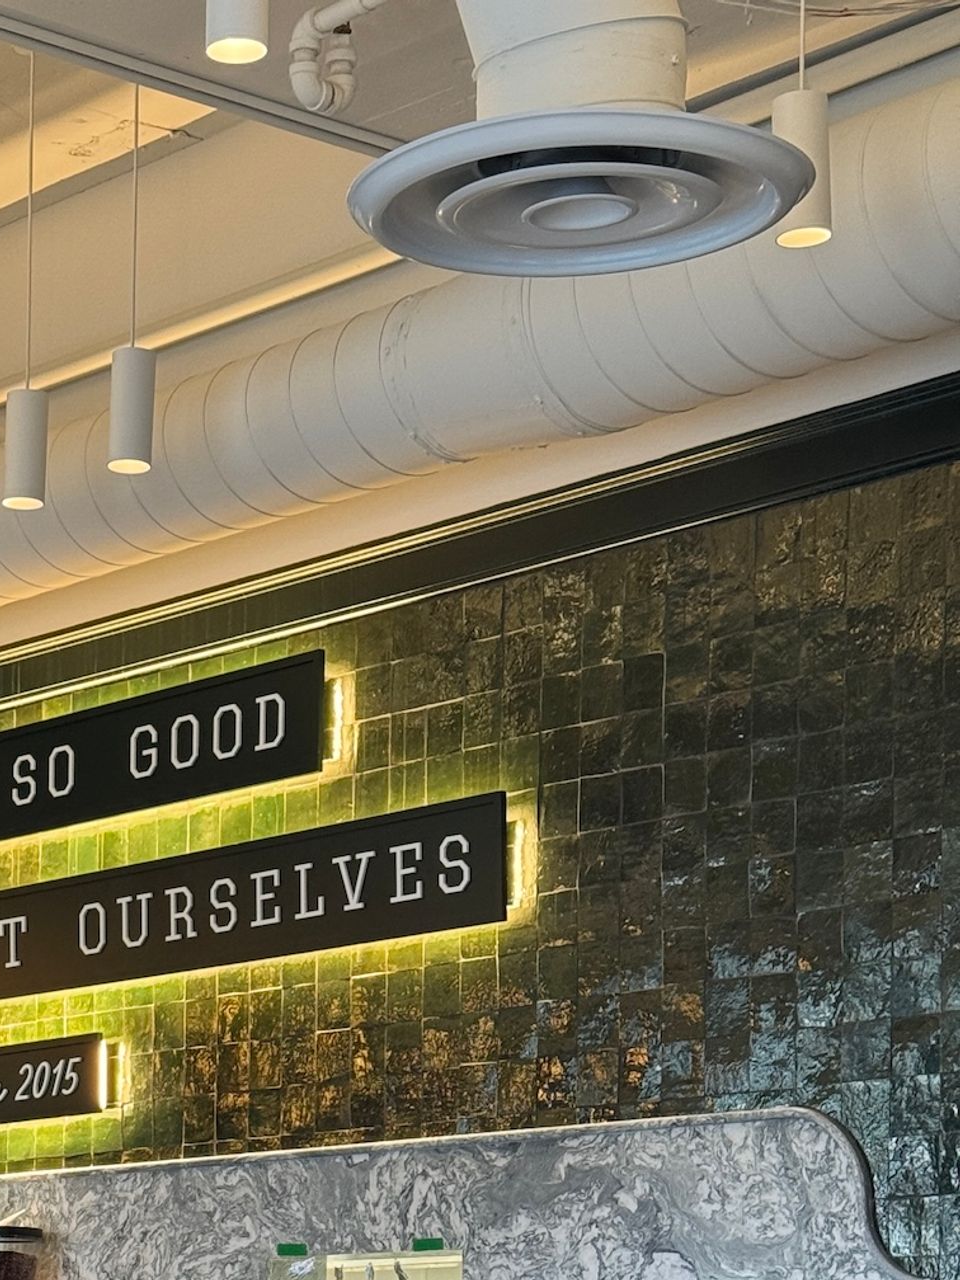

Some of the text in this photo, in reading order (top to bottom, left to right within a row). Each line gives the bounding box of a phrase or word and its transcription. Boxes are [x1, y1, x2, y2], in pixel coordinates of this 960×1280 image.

[11, 744, 75, 806] SO
[129, 693, 286, 779] GOOD
[78, 834, 471, 955] OURSELVES
[14, 1057, 82, 1101] 2015
